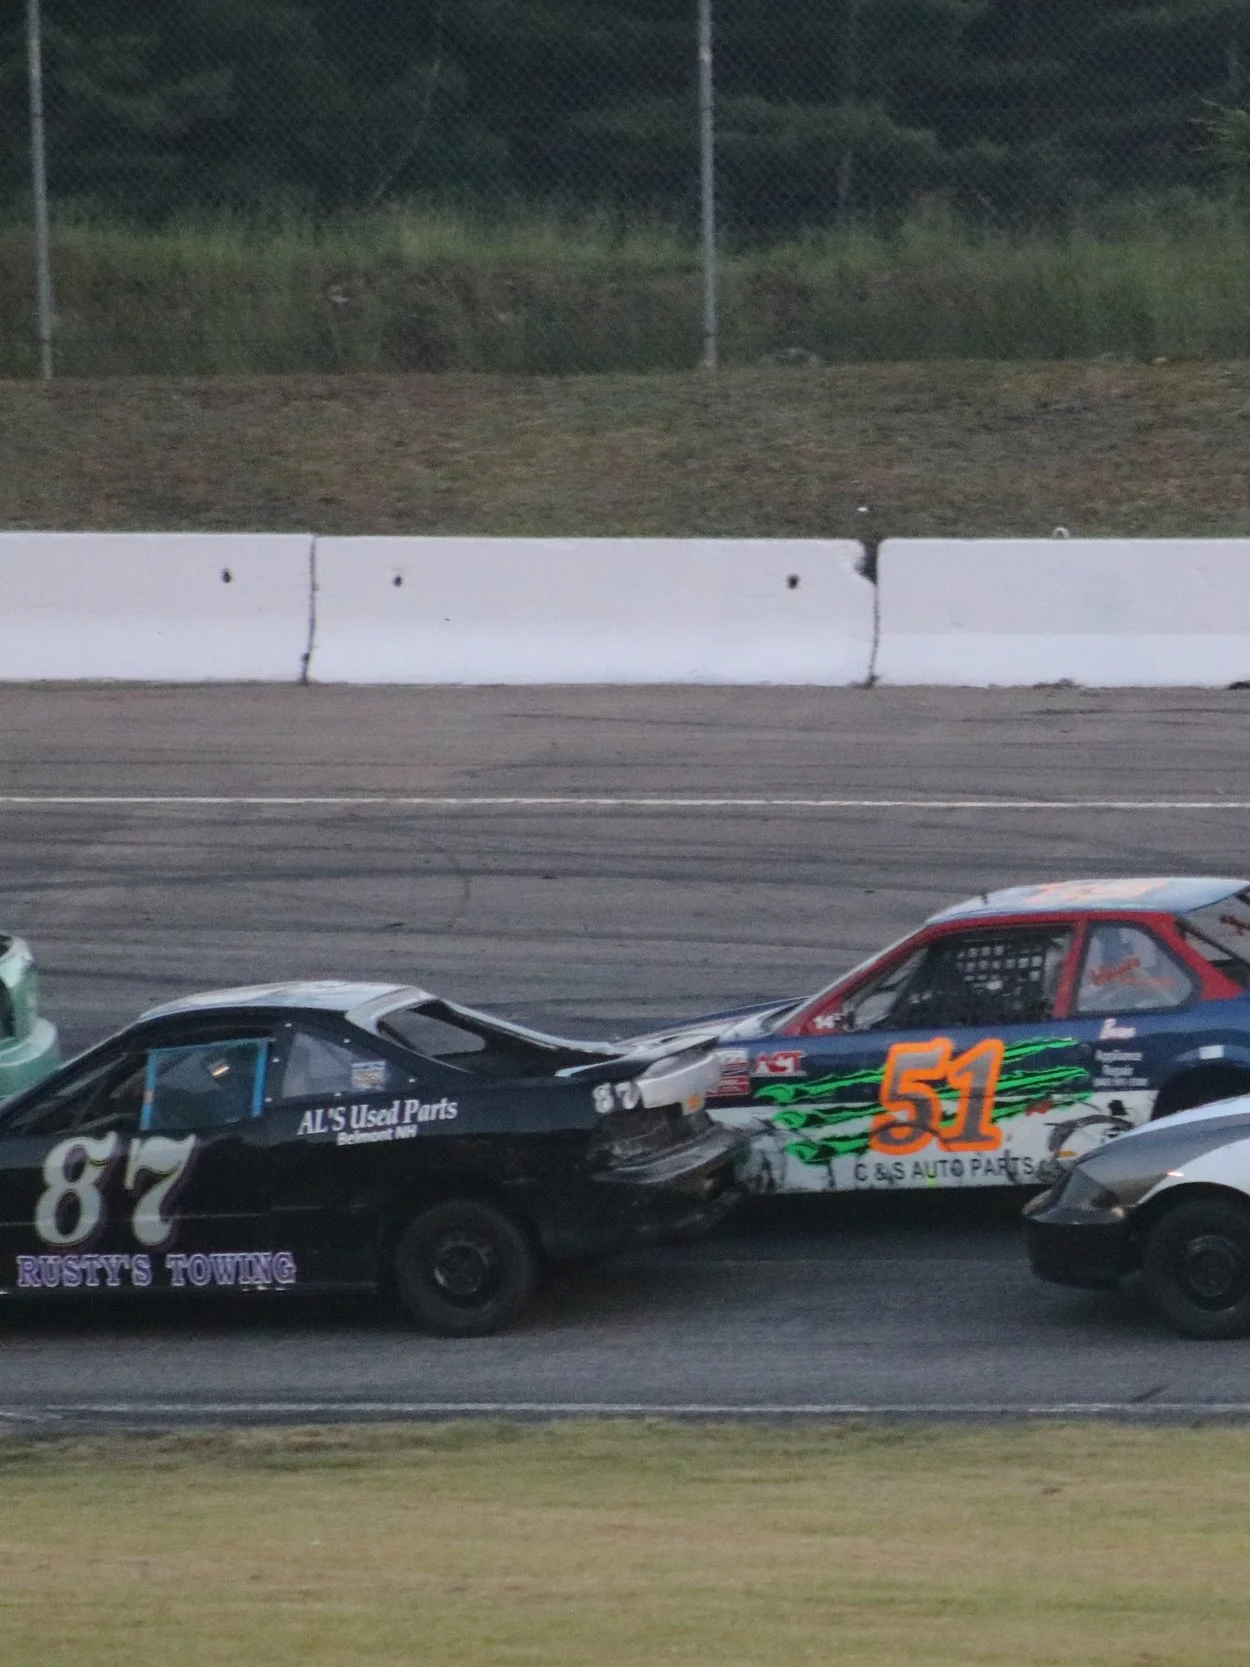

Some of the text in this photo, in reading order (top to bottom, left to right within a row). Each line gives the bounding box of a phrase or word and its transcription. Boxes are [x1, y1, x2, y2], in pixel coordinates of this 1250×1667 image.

[593, 1081, 641, 1113] 87
[870, 1036, 1005, 1156] 51
[297, 1097, 459, 1135] AL'S Used Parts
[854, 1163, 868, 1182] C
[912, 1157, 965, 1179] AUTO
[971, 1156, 1033, 1178] PARTS
[34, 1130, 197, 1247] 87
[16, 1251, 297, 1288] RUSTY'S TOWING
